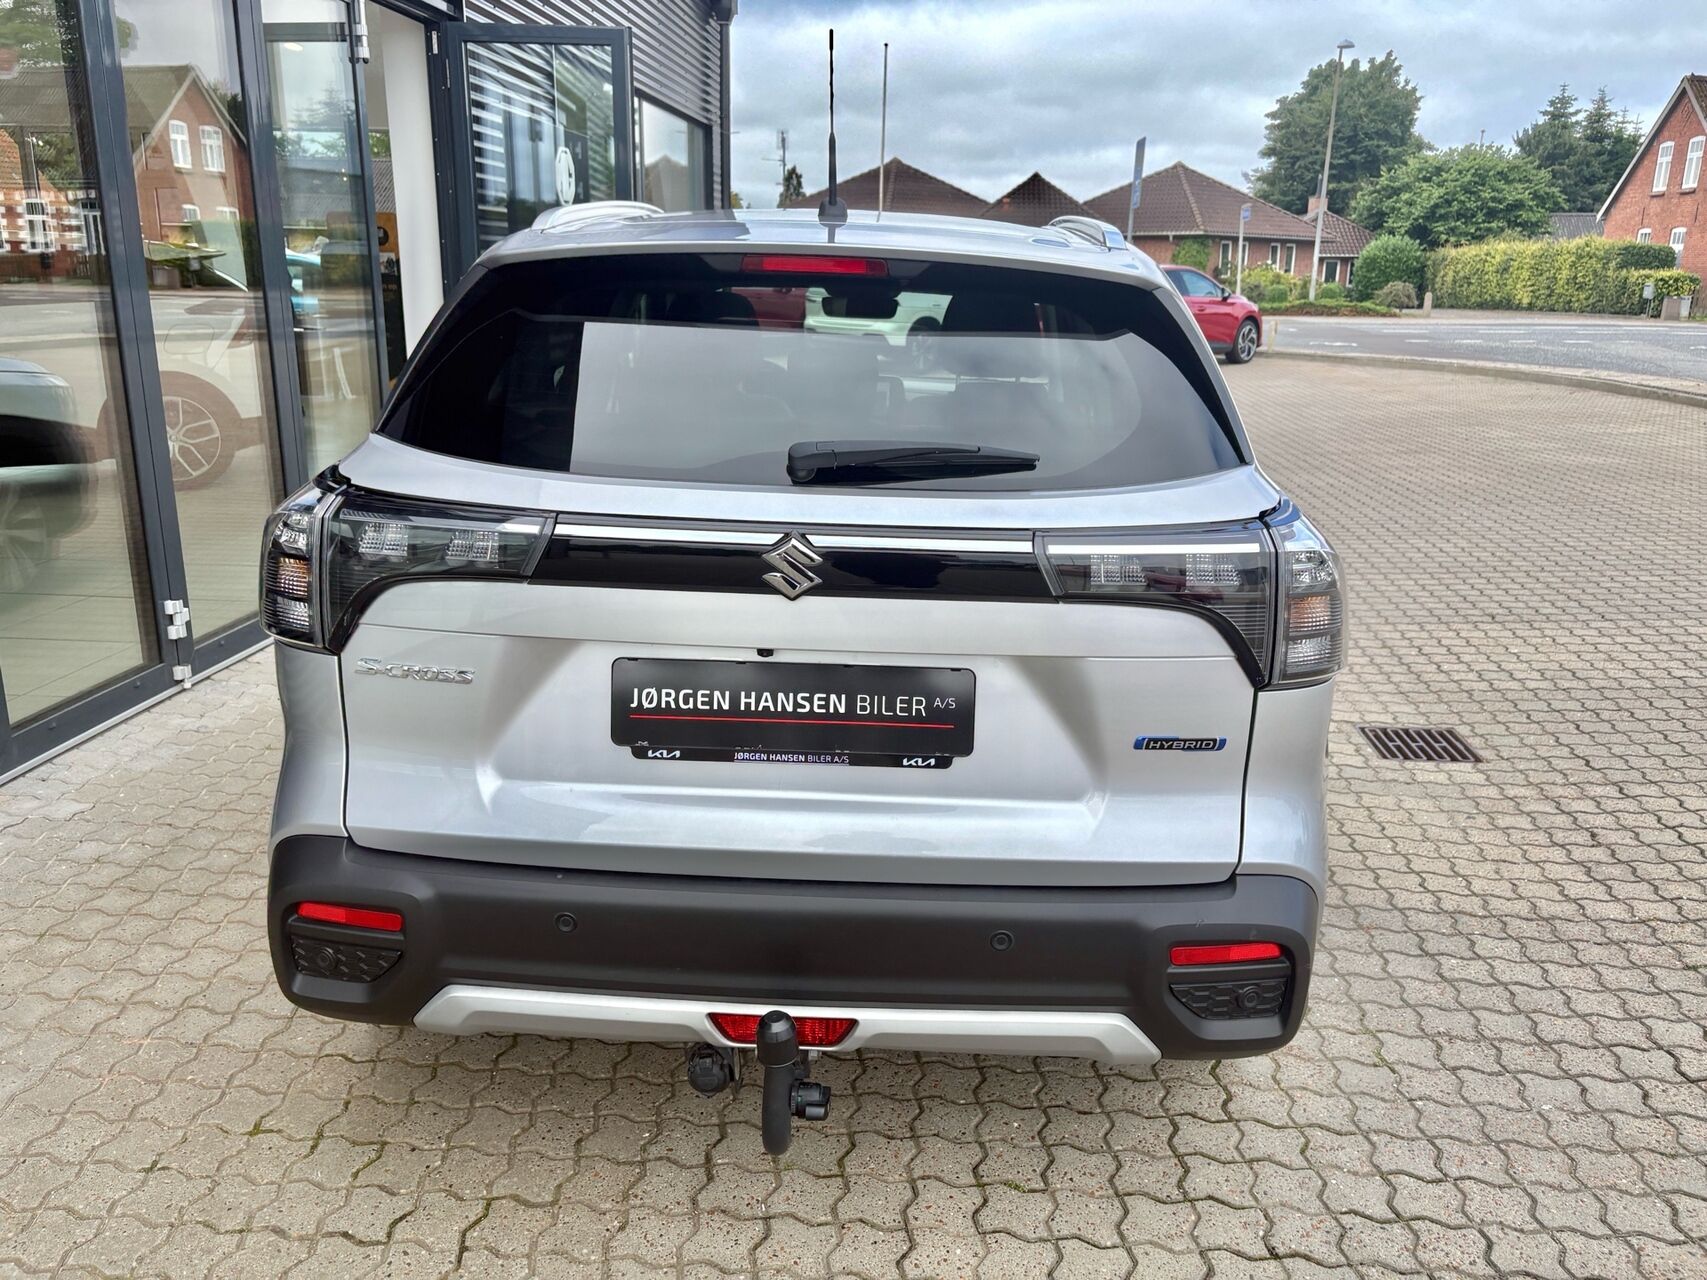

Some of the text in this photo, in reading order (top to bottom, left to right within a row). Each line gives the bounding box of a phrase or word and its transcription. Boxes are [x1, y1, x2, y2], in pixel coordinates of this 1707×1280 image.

[630, 687, 956, 717] JØRGEN HANSEN BILER A/S
[1149, 740, 1214, 749] HYBRID
[734, 752, 849, 764] JØRGEN HANSEN BILER A/S
